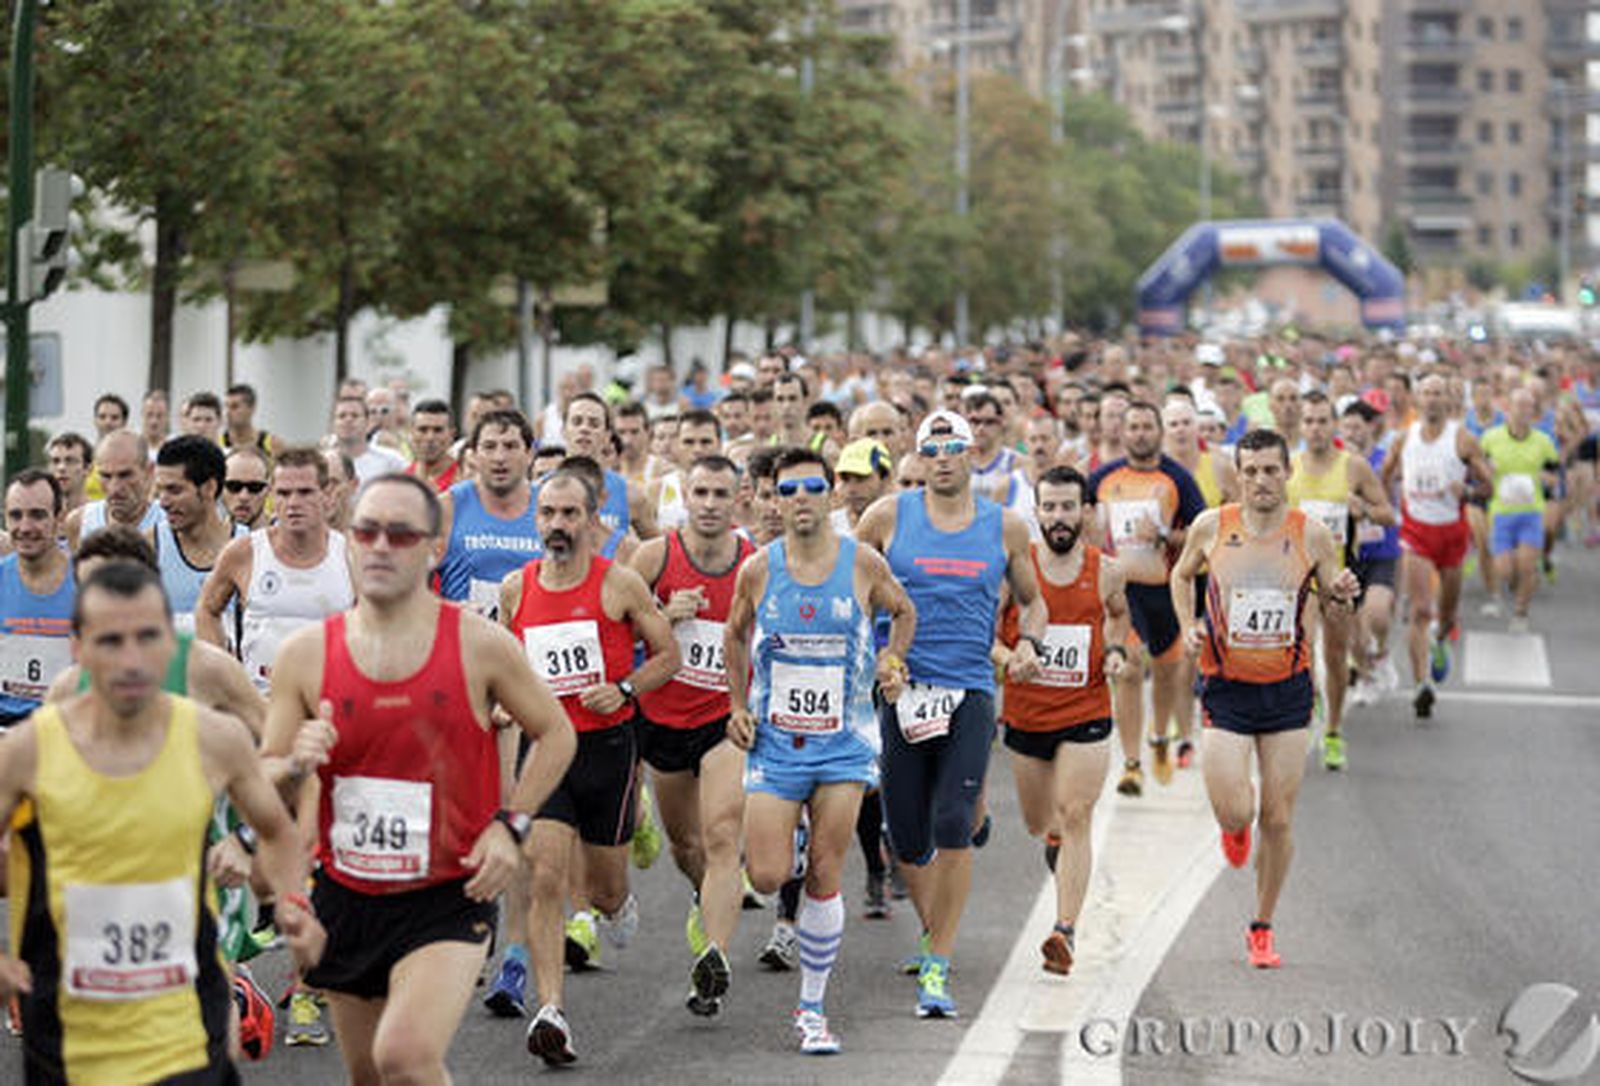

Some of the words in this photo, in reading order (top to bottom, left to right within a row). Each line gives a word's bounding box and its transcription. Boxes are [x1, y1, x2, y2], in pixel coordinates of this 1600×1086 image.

[1246, 609, 1284, 631] 477
[28, 658, 41, 682] 6
[547, 645, 589, 675] 318
[789, 688, 830, 715] 594
[914, 694, 955, 720] 470
[353, 812, 407, 850] 349
[102, 921, 171, 964] 382
